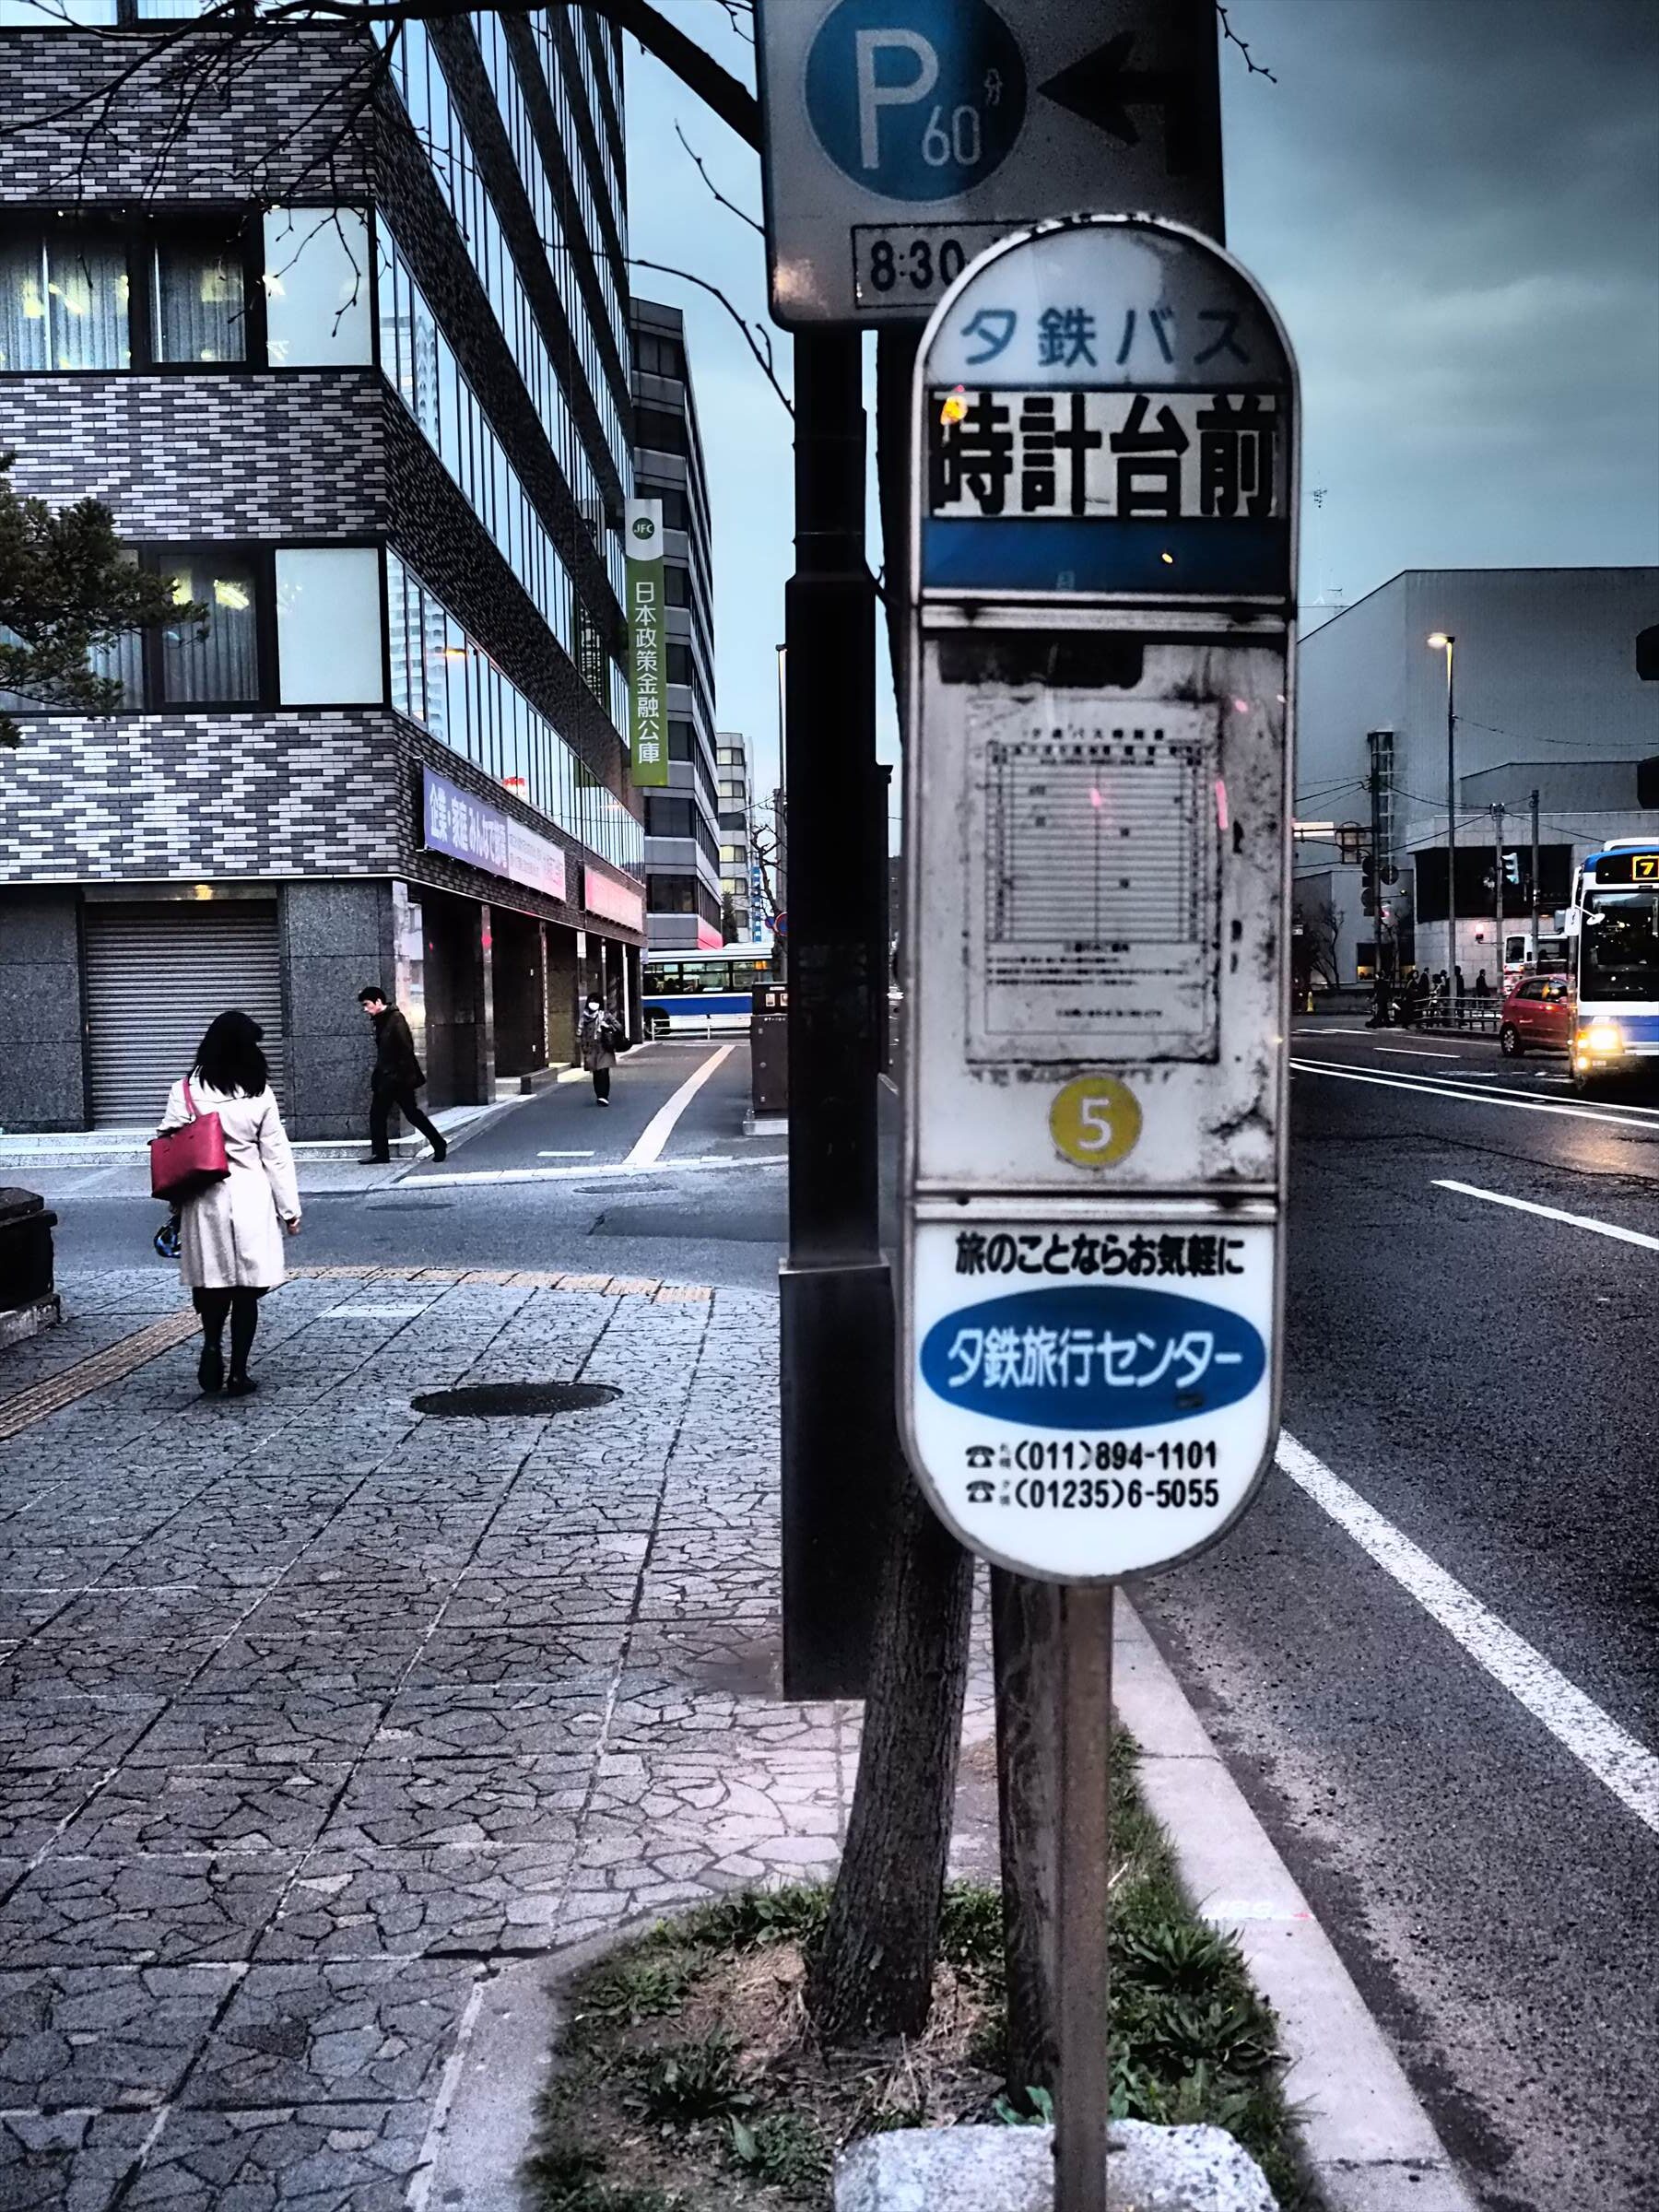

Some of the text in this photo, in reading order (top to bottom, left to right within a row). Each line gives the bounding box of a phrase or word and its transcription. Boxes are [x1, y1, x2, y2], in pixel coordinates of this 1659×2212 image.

[855, 29, 938, 169] P
[929, 391, 1277, 516] 時計台前
[633, 524, 653, 534] JFC
[635, 582, 660, 764] 日本政策金融公庫
[1641, 863, 1654, 875] 7
[1077, 1098, 1112, 1150] 5
[956, 1233, 1244, 1277] 旅のことならお気軽に
[1015, 1440, 1217, 1471] (011)894-1101
[1015, 1478, 1219, 1510] (01235)6-5055
